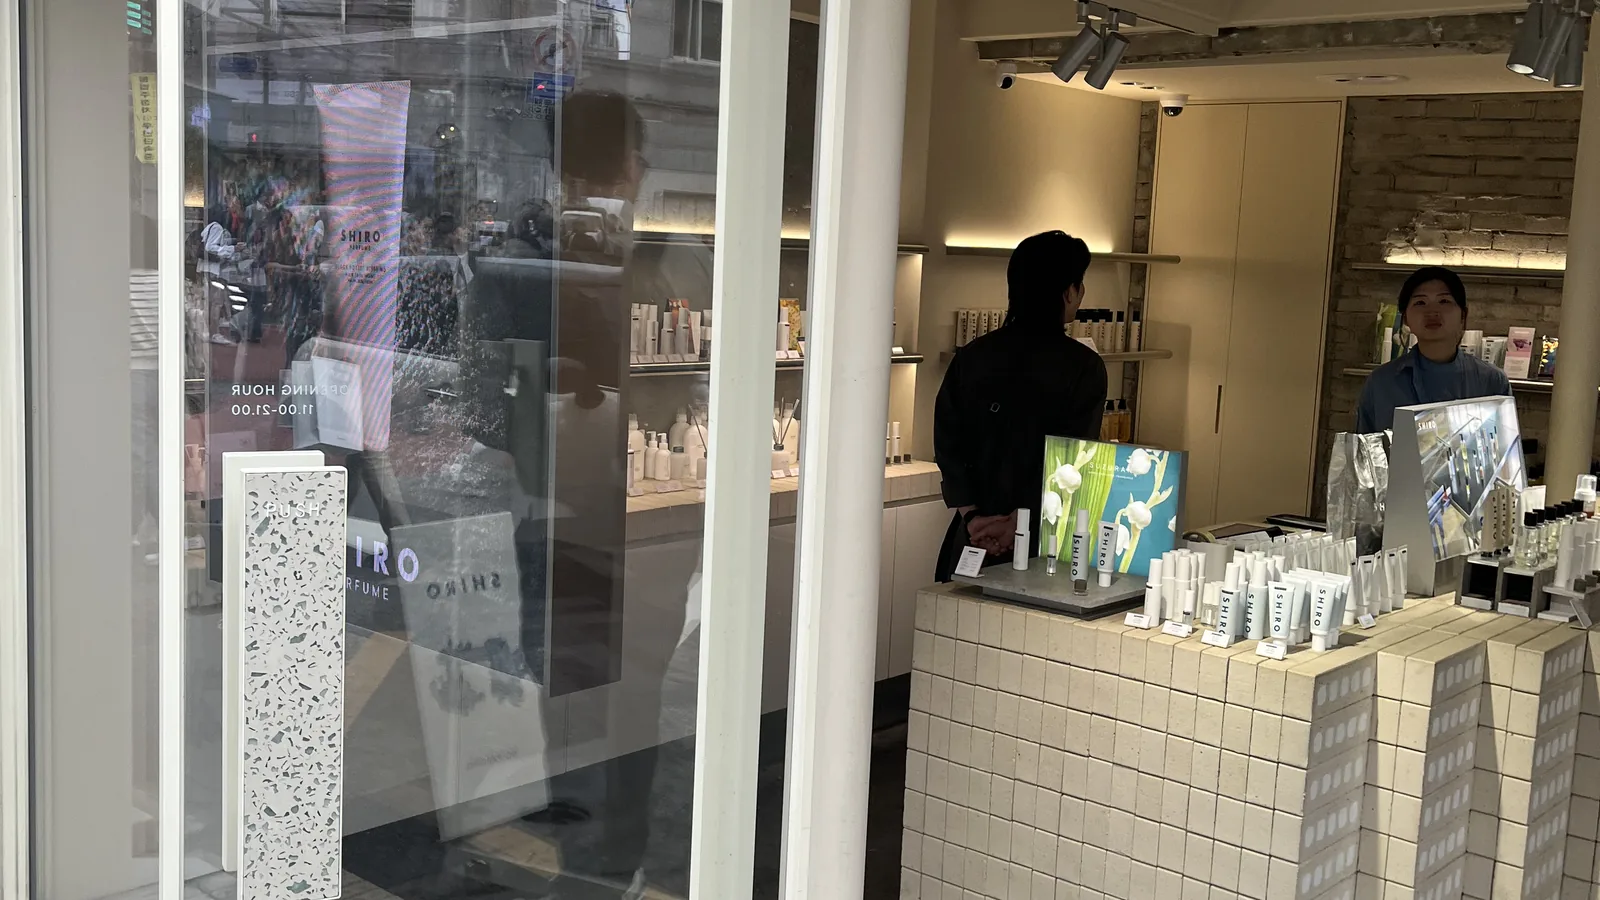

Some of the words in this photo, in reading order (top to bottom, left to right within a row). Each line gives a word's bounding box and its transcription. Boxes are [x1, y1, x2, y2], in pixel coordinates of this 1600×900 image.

[341, 229, 381, 243] SHIRO
[1418, 421, 1437, 431] SHIRO
[265, 502, 320, 518] PUSH
[356, 535, 419, 583] IRO
[1071, 538, 1081, 577] SHIRO
[1099, 531, 1110, 567] SHIRO
[346, 576, 389, 601] RFUME
[1244, 593, 1255, 634] SHIRO
[1273, 593, 1284, 633] SHIRO
[1314, 589, 1327, 628] SHIRO
